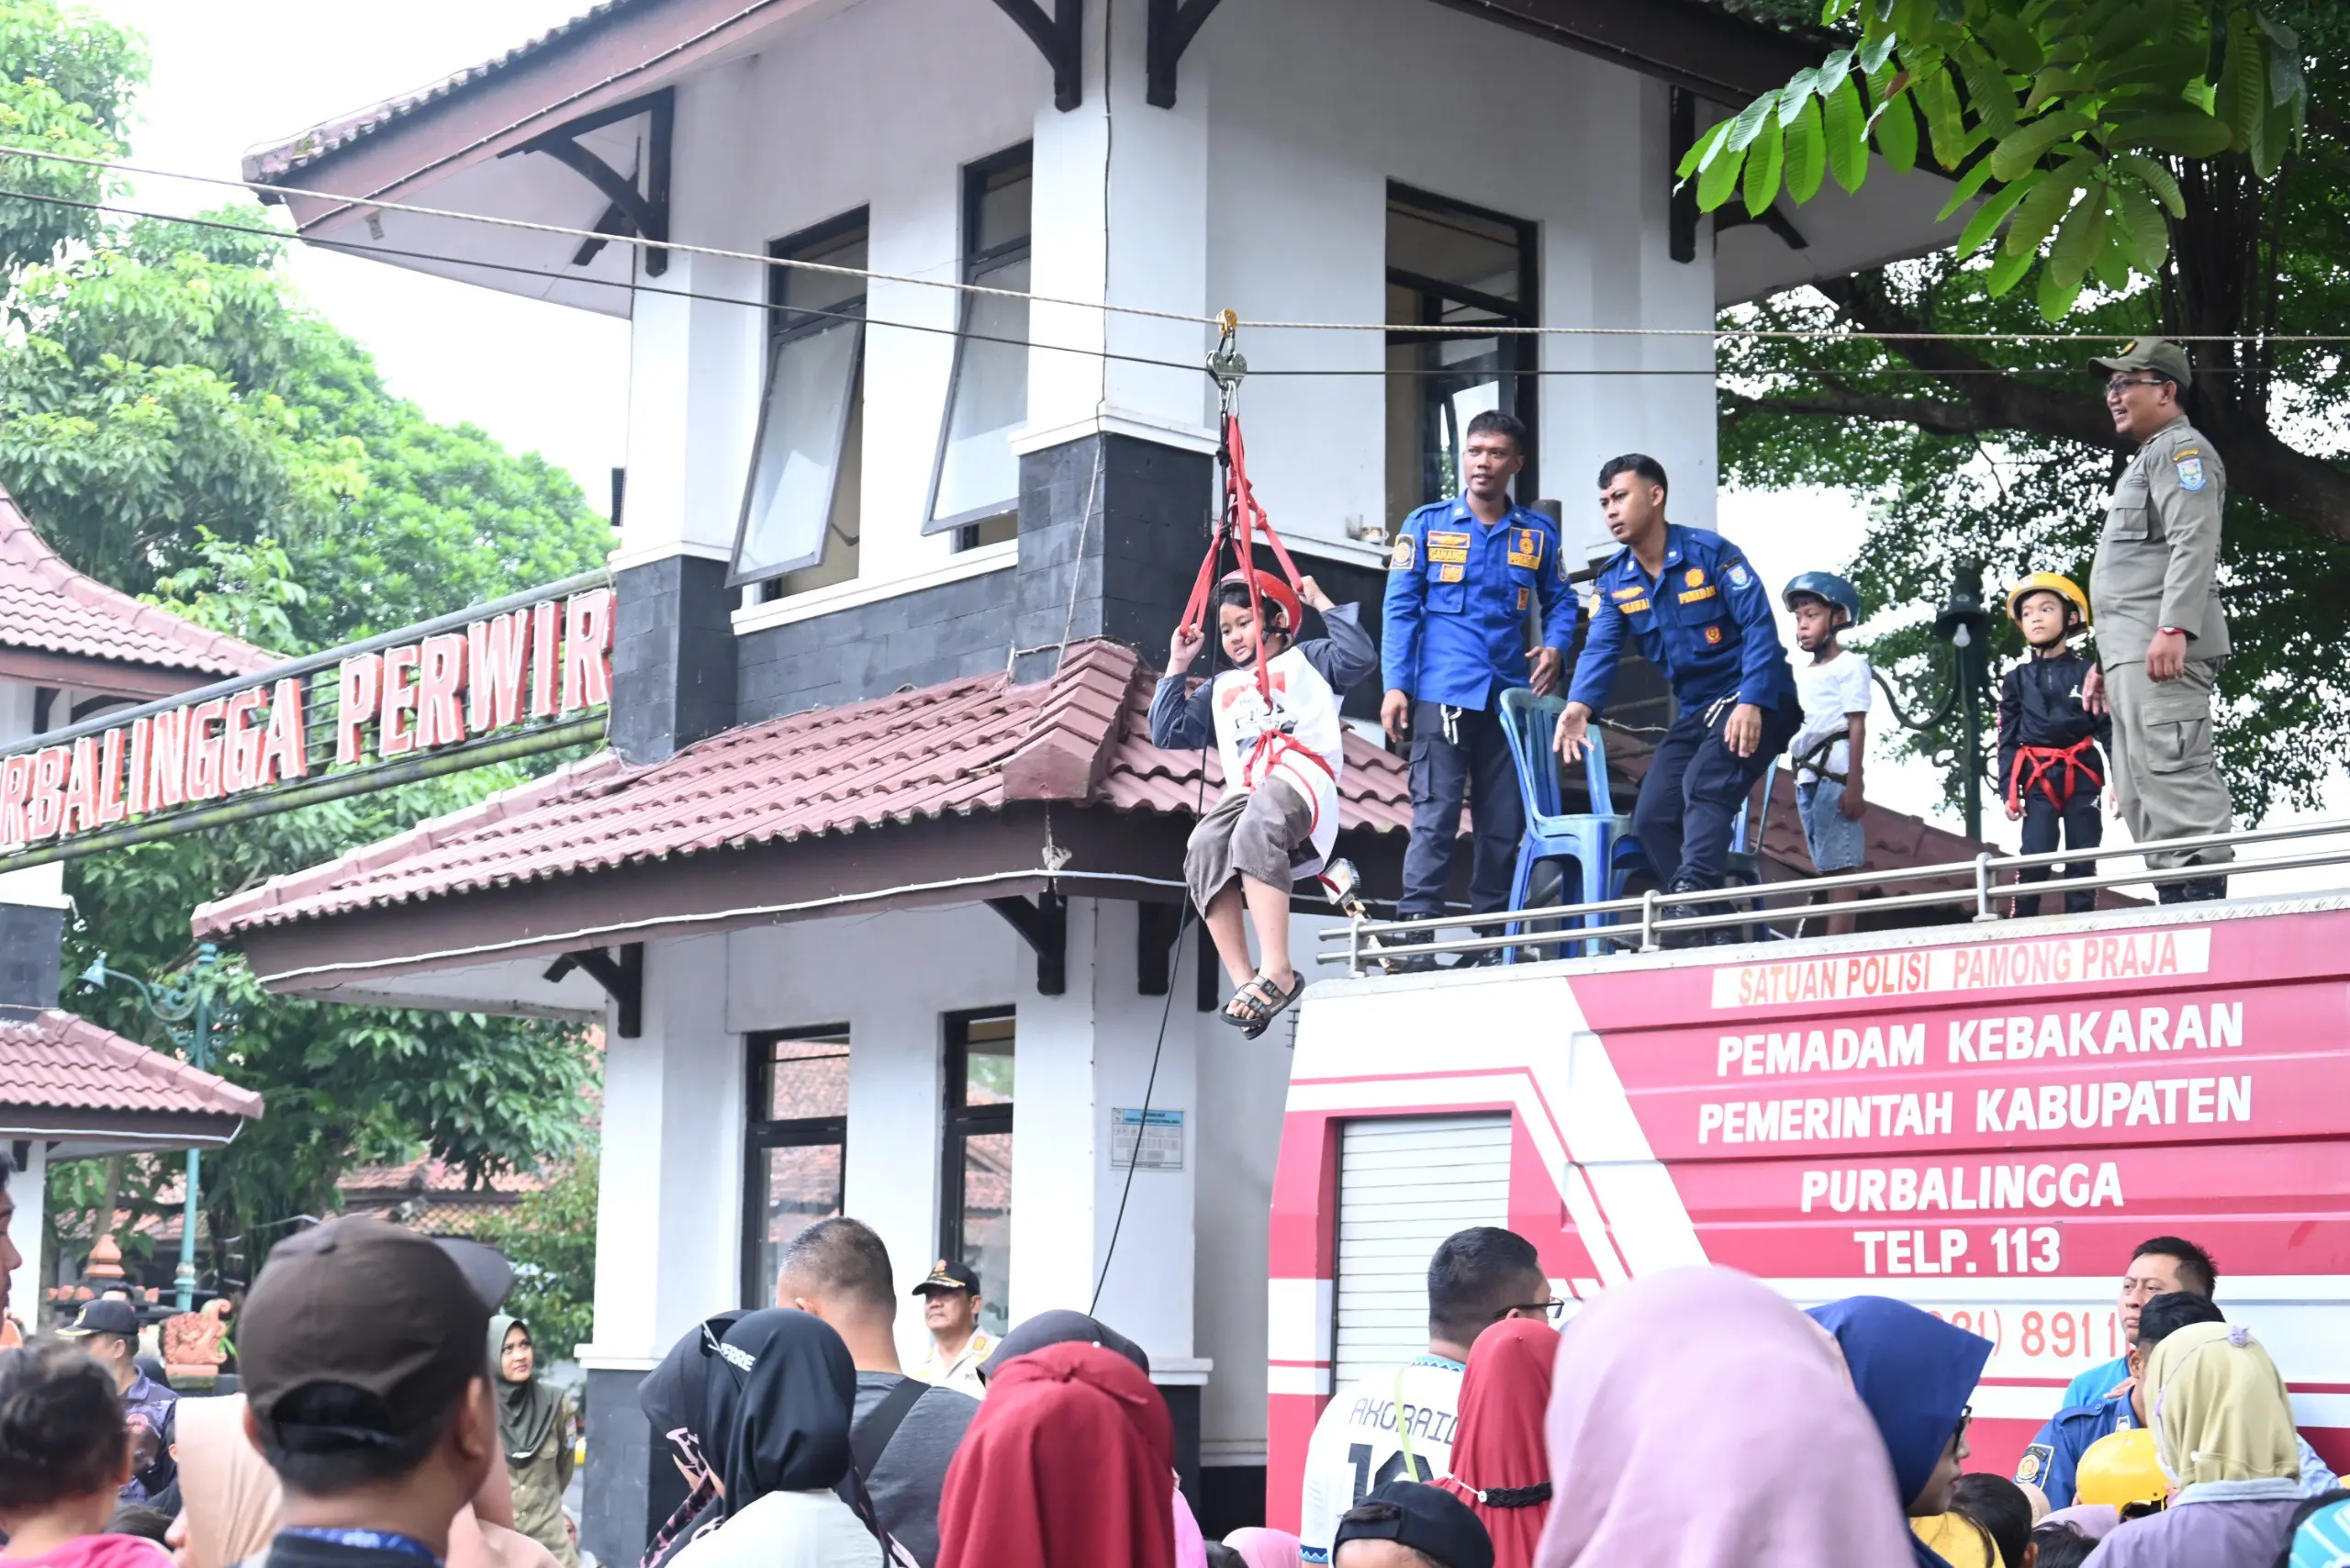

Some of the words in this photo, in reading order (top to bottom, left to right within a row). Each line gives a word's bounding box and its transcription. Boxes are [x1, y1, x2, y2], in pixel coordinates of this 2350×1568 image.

[0, 678, 307, 845] RBALINGGA
[1739, 960, 1838, 1006] SATUAN
[1846, 951, 1931, 995] POLISI
[1953, 940, 2072, 990] PAMONG
[2081, 932, 2179, 980] PRAJA
[1717, 1023, 1927, 1077] PEMADAM
[1947, 1002, 2244, 1064] KEBAKARAN
[1697, 1091, 1954, 1145] PEMERINTAH
[1975, 1075, 2253, 1133] KABUPATEN
[1800, 1162, 2125, 1213] PURBALINGGA
[1853, 1228, 1977, 1275] TELP.
[1990, 1226, 2062, 1273] 113
